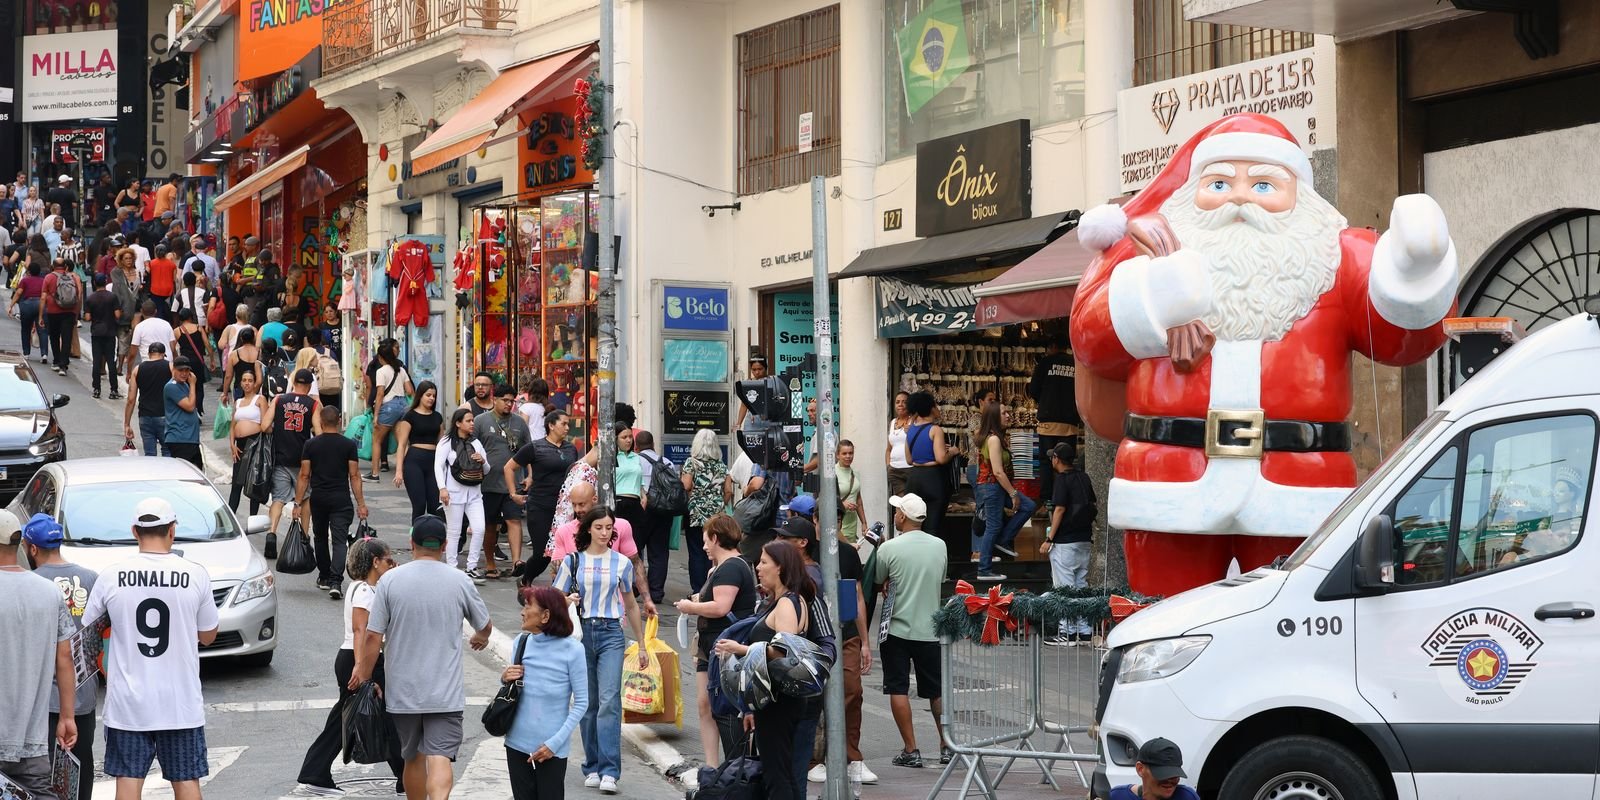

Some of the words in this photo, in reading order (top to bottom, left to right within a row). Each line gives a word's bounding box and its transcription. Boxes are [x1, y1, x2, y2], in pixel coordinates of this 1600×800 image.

[32, 49, 116, 77] MILLA
[1188, 73, 1246, 111] PRATA
[1250, 66, 1274, 99] DE
[32, 99, 117, 110] www.millacabelos.com.br
[150, 33, 168, 170] CBELO
[1277, 91, 1313, 110] VAREJO
[937, 144, 998, 207] Ônix
[884, 211, 901, 228] 127
[972, 203, 998, 220] bijoux
[686, 296, 725, 316] Belo
[783, 308, 799, 316] Aqui
[986, 305, 998, 319] 133
[908, 312, 946, 331] 1,99
[780, 355, 805, 364] Bijou
[1052, 364, 1075, 372] POSSO
[284, 411, 304, 432] 23
[118, 570, 190, 589] RONALDO
[136, 597, 170, 658] 9
[1302, 615, 1343, 636] 190
[1428, 612, 1479, 653] POLÍCIA
[1485, 612, 1536, 650] MILITAR
[1465, 695, 1479, 705] SÃO
[1481, 695, 1503, 705] PAULO
